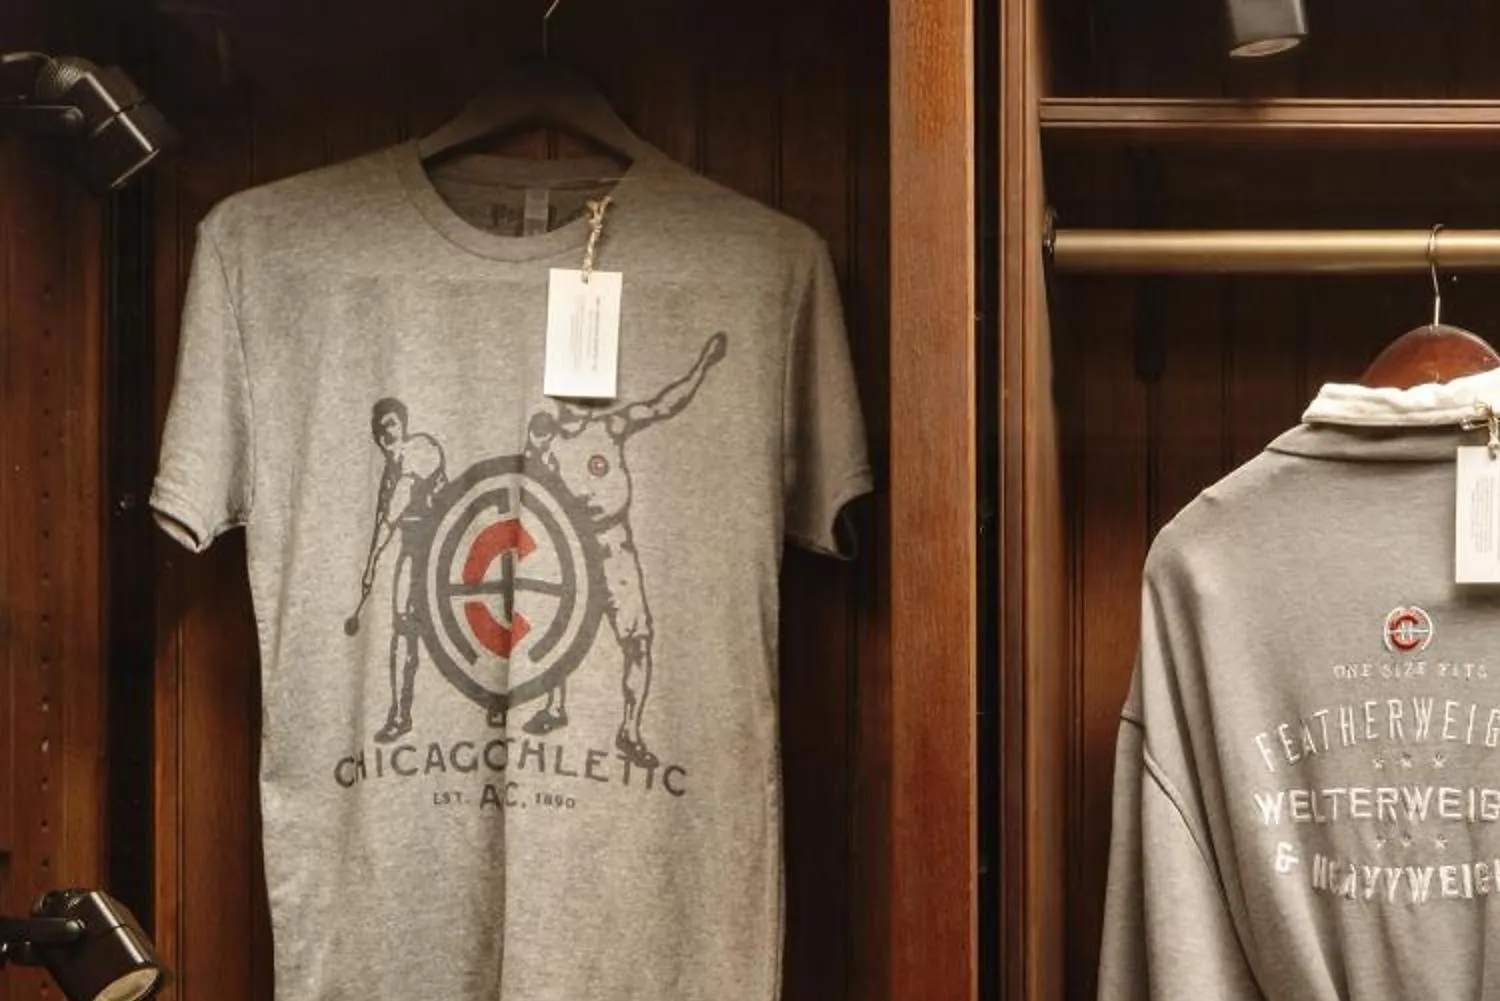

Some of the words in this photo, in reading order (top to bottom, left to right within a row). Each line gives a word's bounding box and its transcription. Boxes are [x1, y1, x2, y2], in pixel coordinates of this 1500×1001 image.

[1332, 664, 1373, 680] ONE
[1380, 661, 1427, 679] SIZE
[1437, 662, 1488, 679] FITS
[333, 738, 508, 788] CHICAGO
